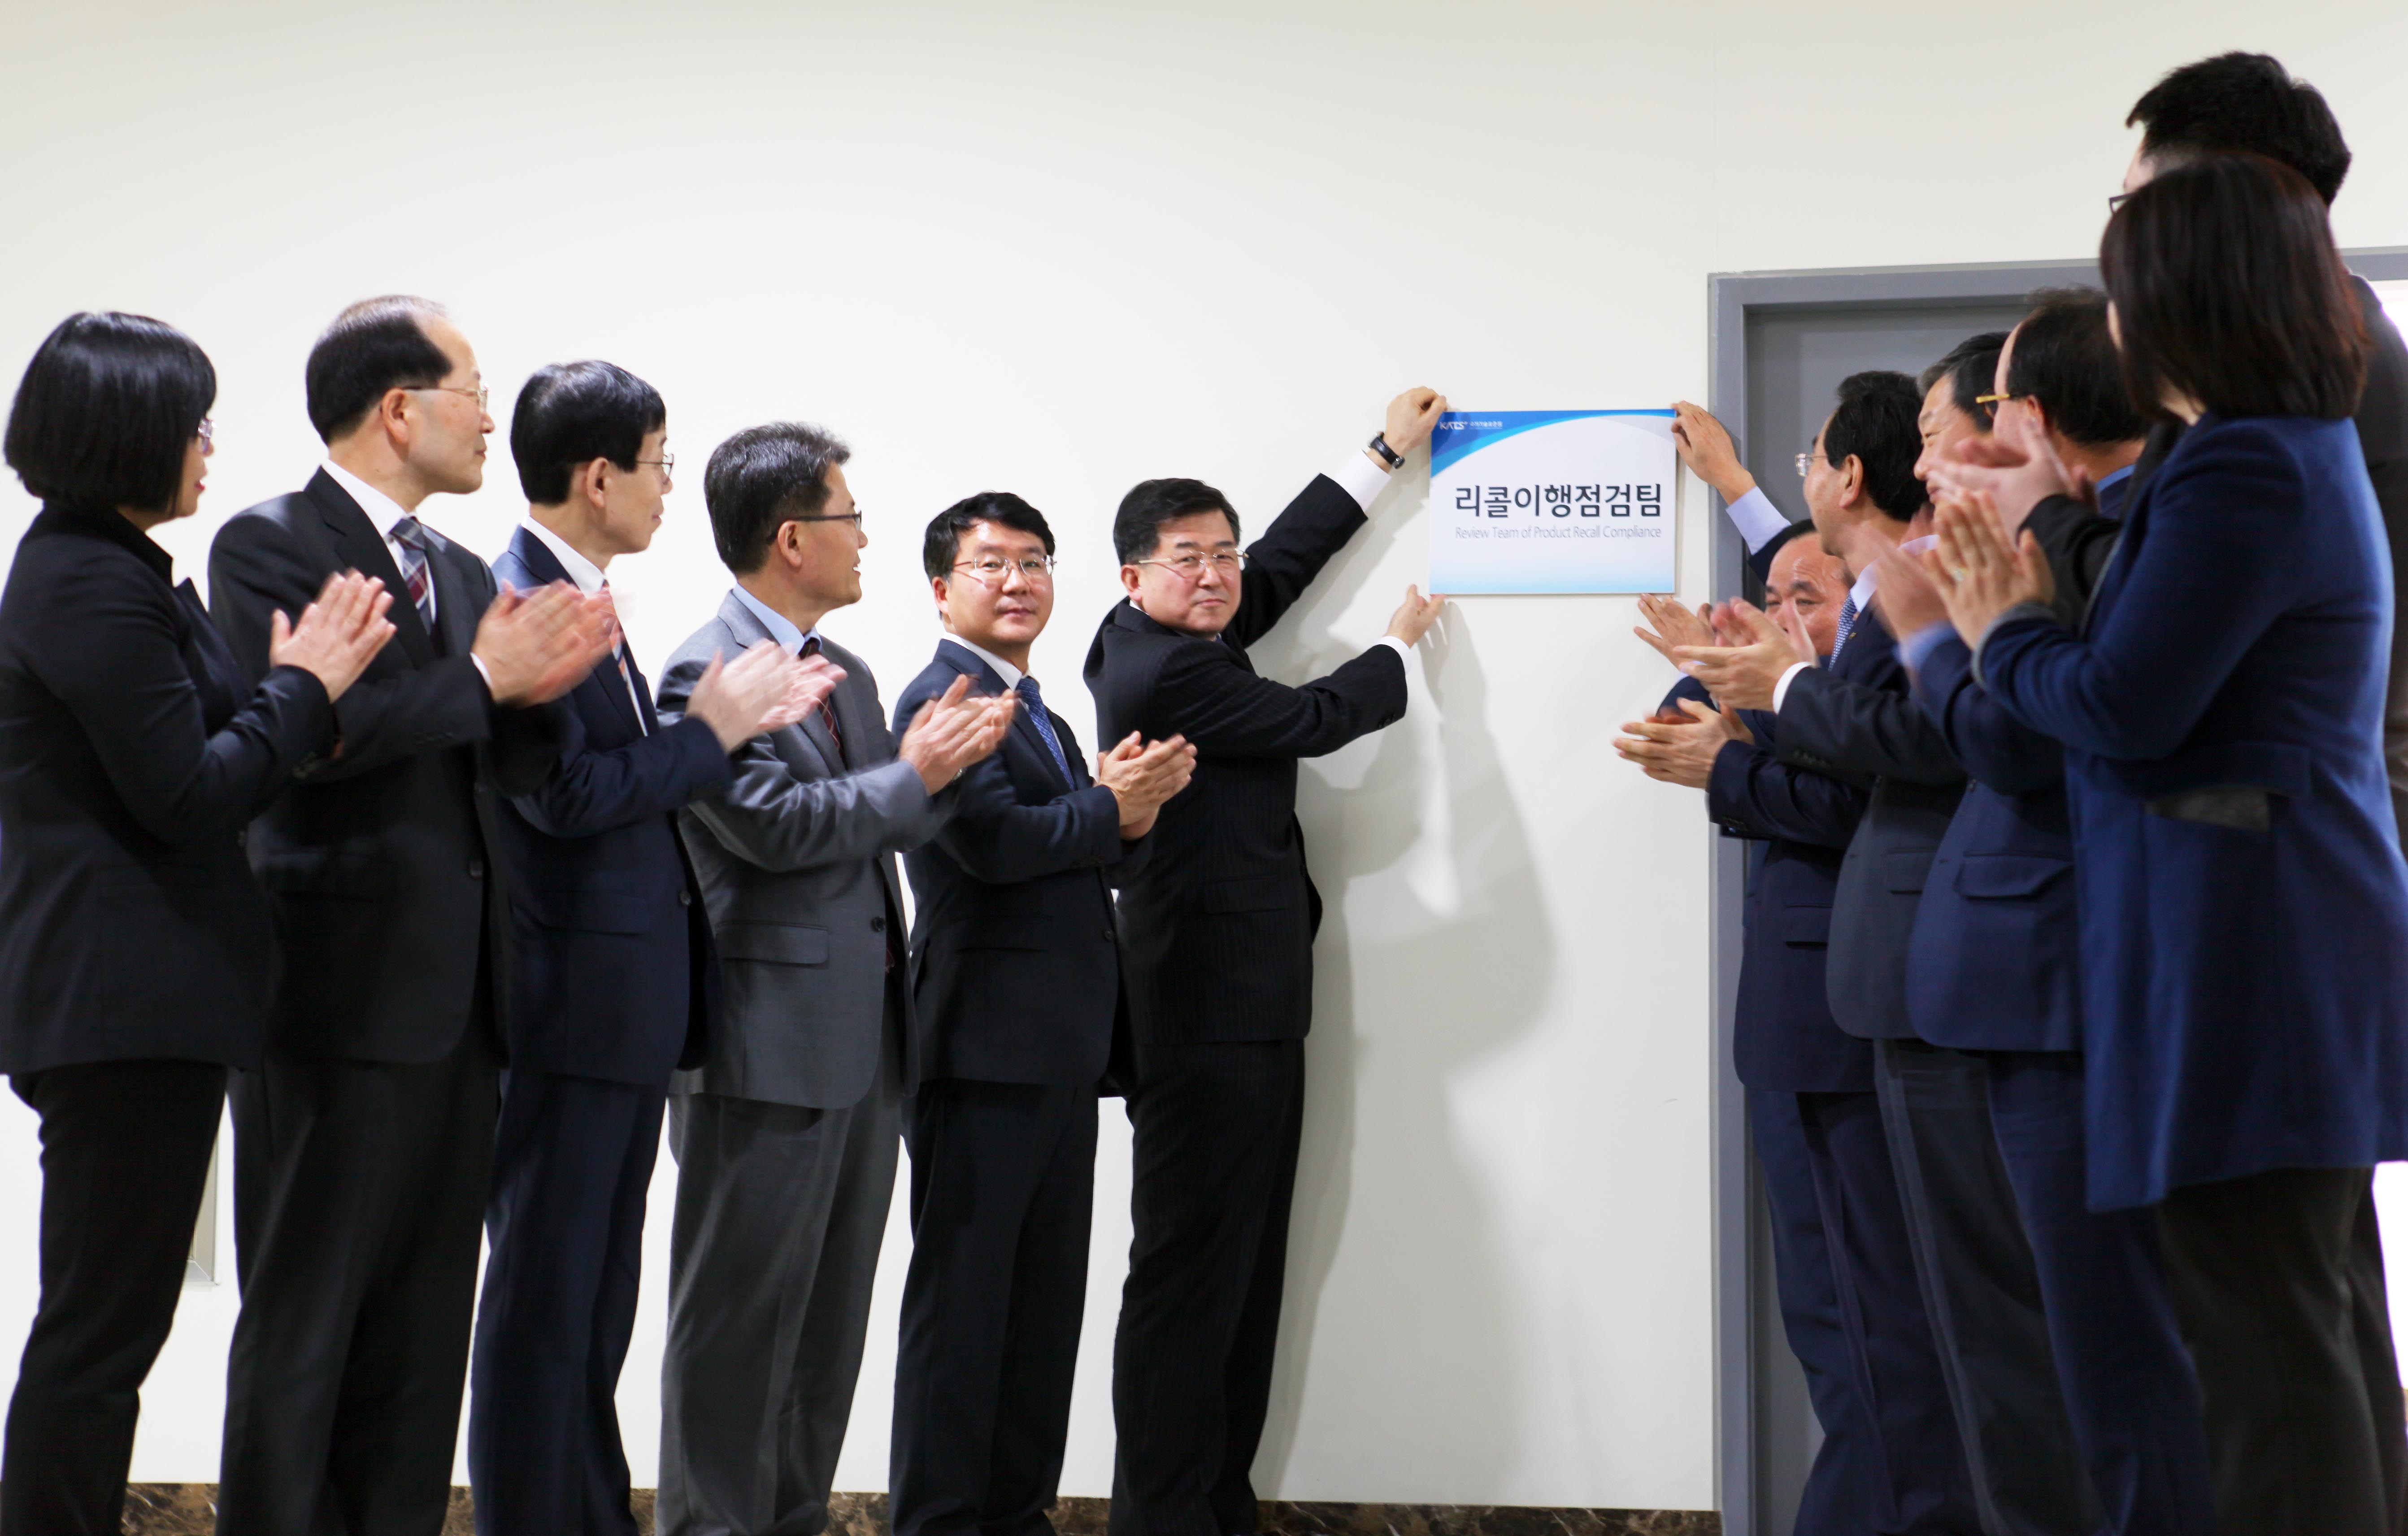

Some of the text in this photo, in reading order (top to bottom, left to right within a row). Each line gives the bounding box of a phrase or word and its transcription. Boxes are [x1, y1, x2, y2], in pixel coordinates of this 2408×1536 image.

[1456, 484, 1661, 517] 리콜이행점검팀
[1456, 525, 1661, 539] Review Team of Product Recall Compliance
